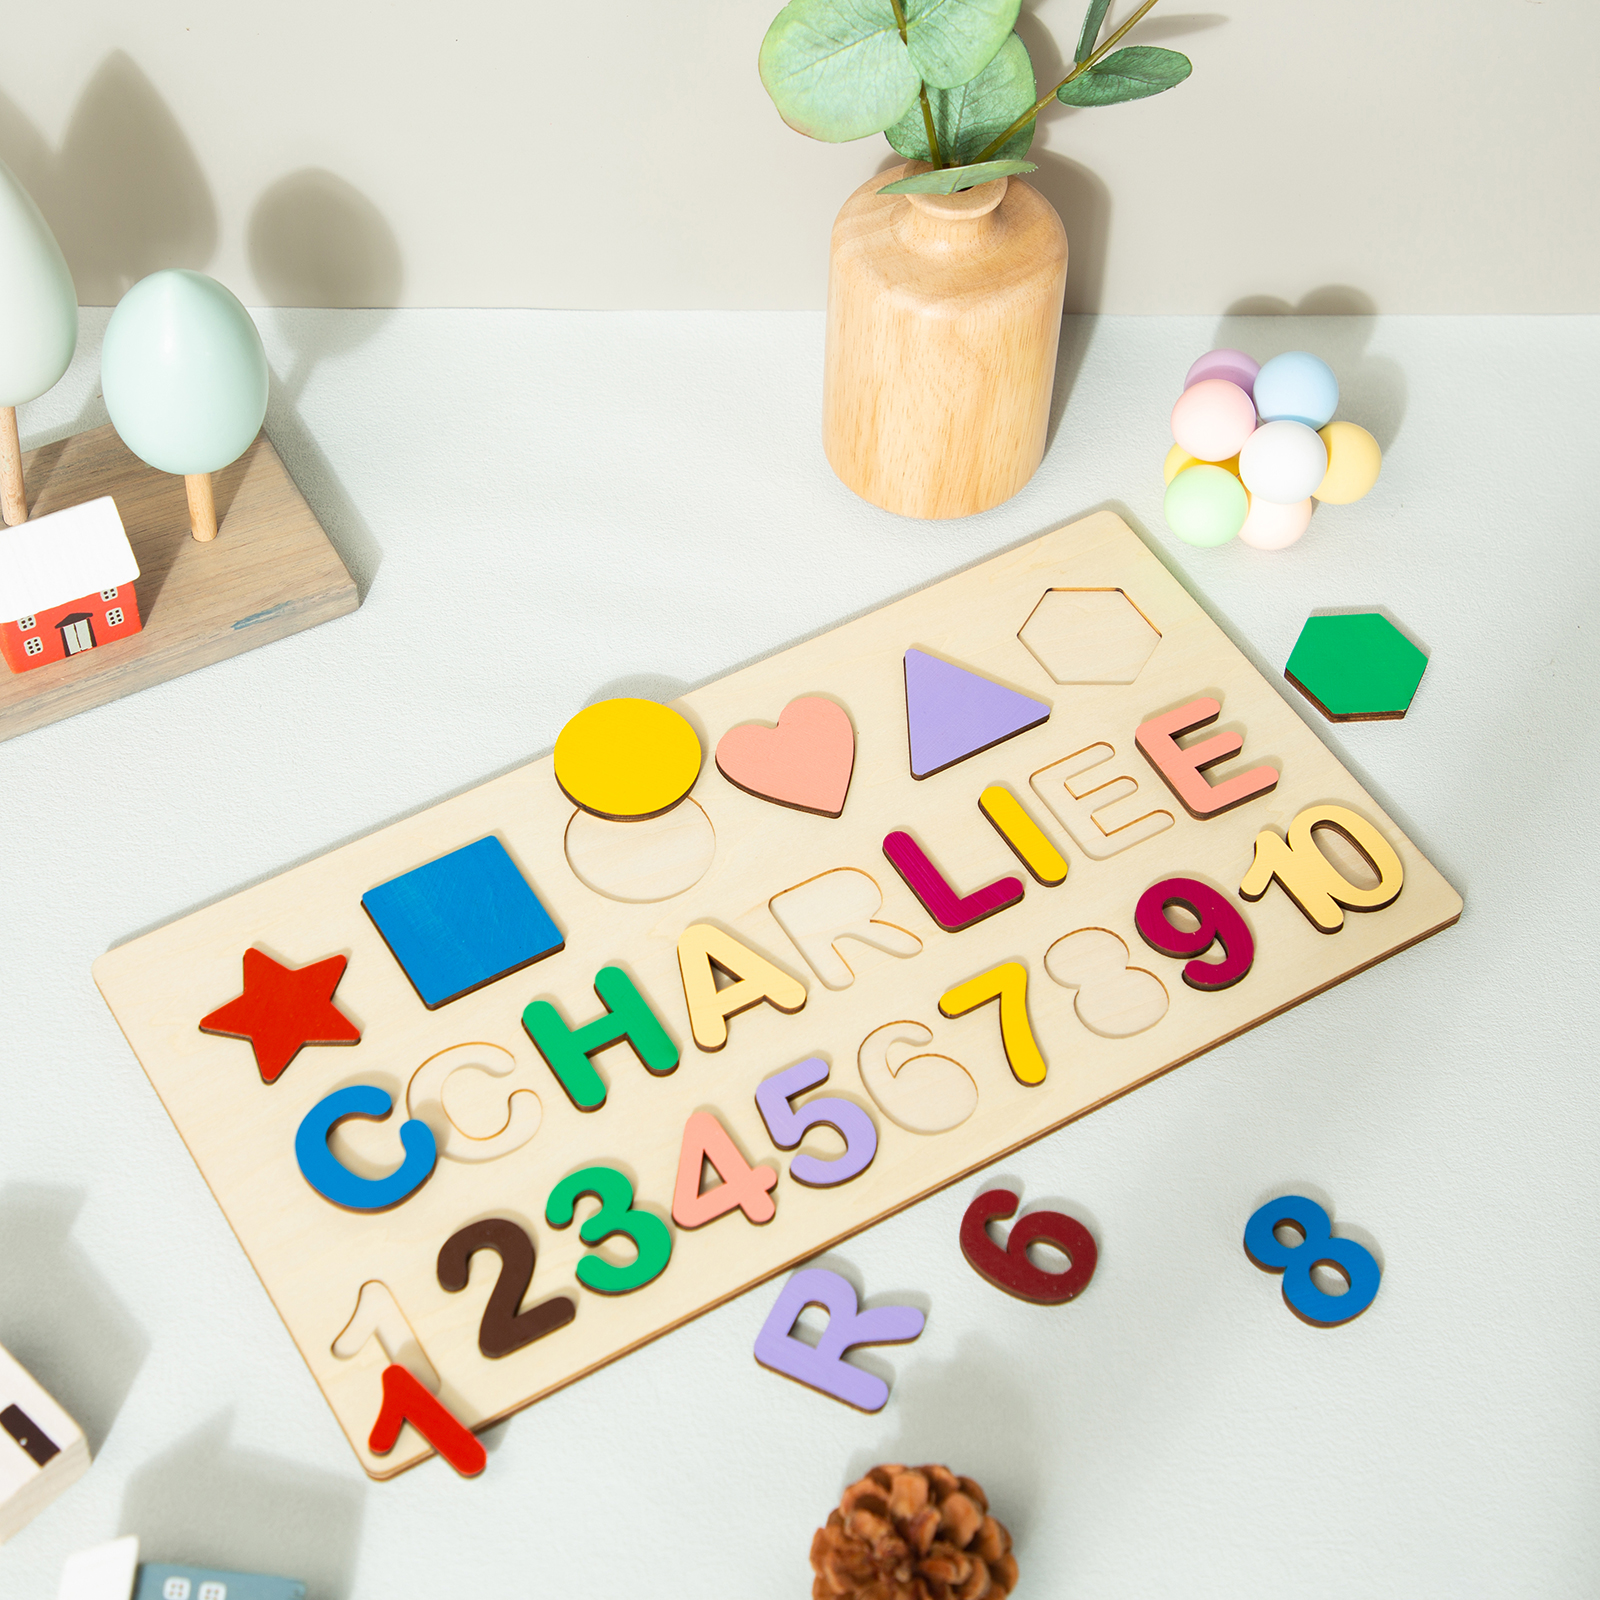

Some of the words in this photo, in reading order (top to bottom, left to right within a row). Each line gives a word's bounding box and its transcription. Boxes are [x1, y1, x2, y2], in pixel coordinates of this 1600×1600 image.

[437, 1218, 576, 1359] 2
[546, 1167, 672, 1296] 3
[672, 1111, 777, 1230] 4
[755, 1057, 877, 1188] 5
[858, 1020, 978, 1135] 6
[938, 962, 1047, 1087] 7
[1135, 877, 1254, 991] 9
[1239, 804, 1404, 935] 10
[959, 1188, 1098, 1306] 6
[1243, 1195, 1381, 1329] 8
[754, 1268, 926, 1414] R
[368, 1364, 487, 1478] 1
